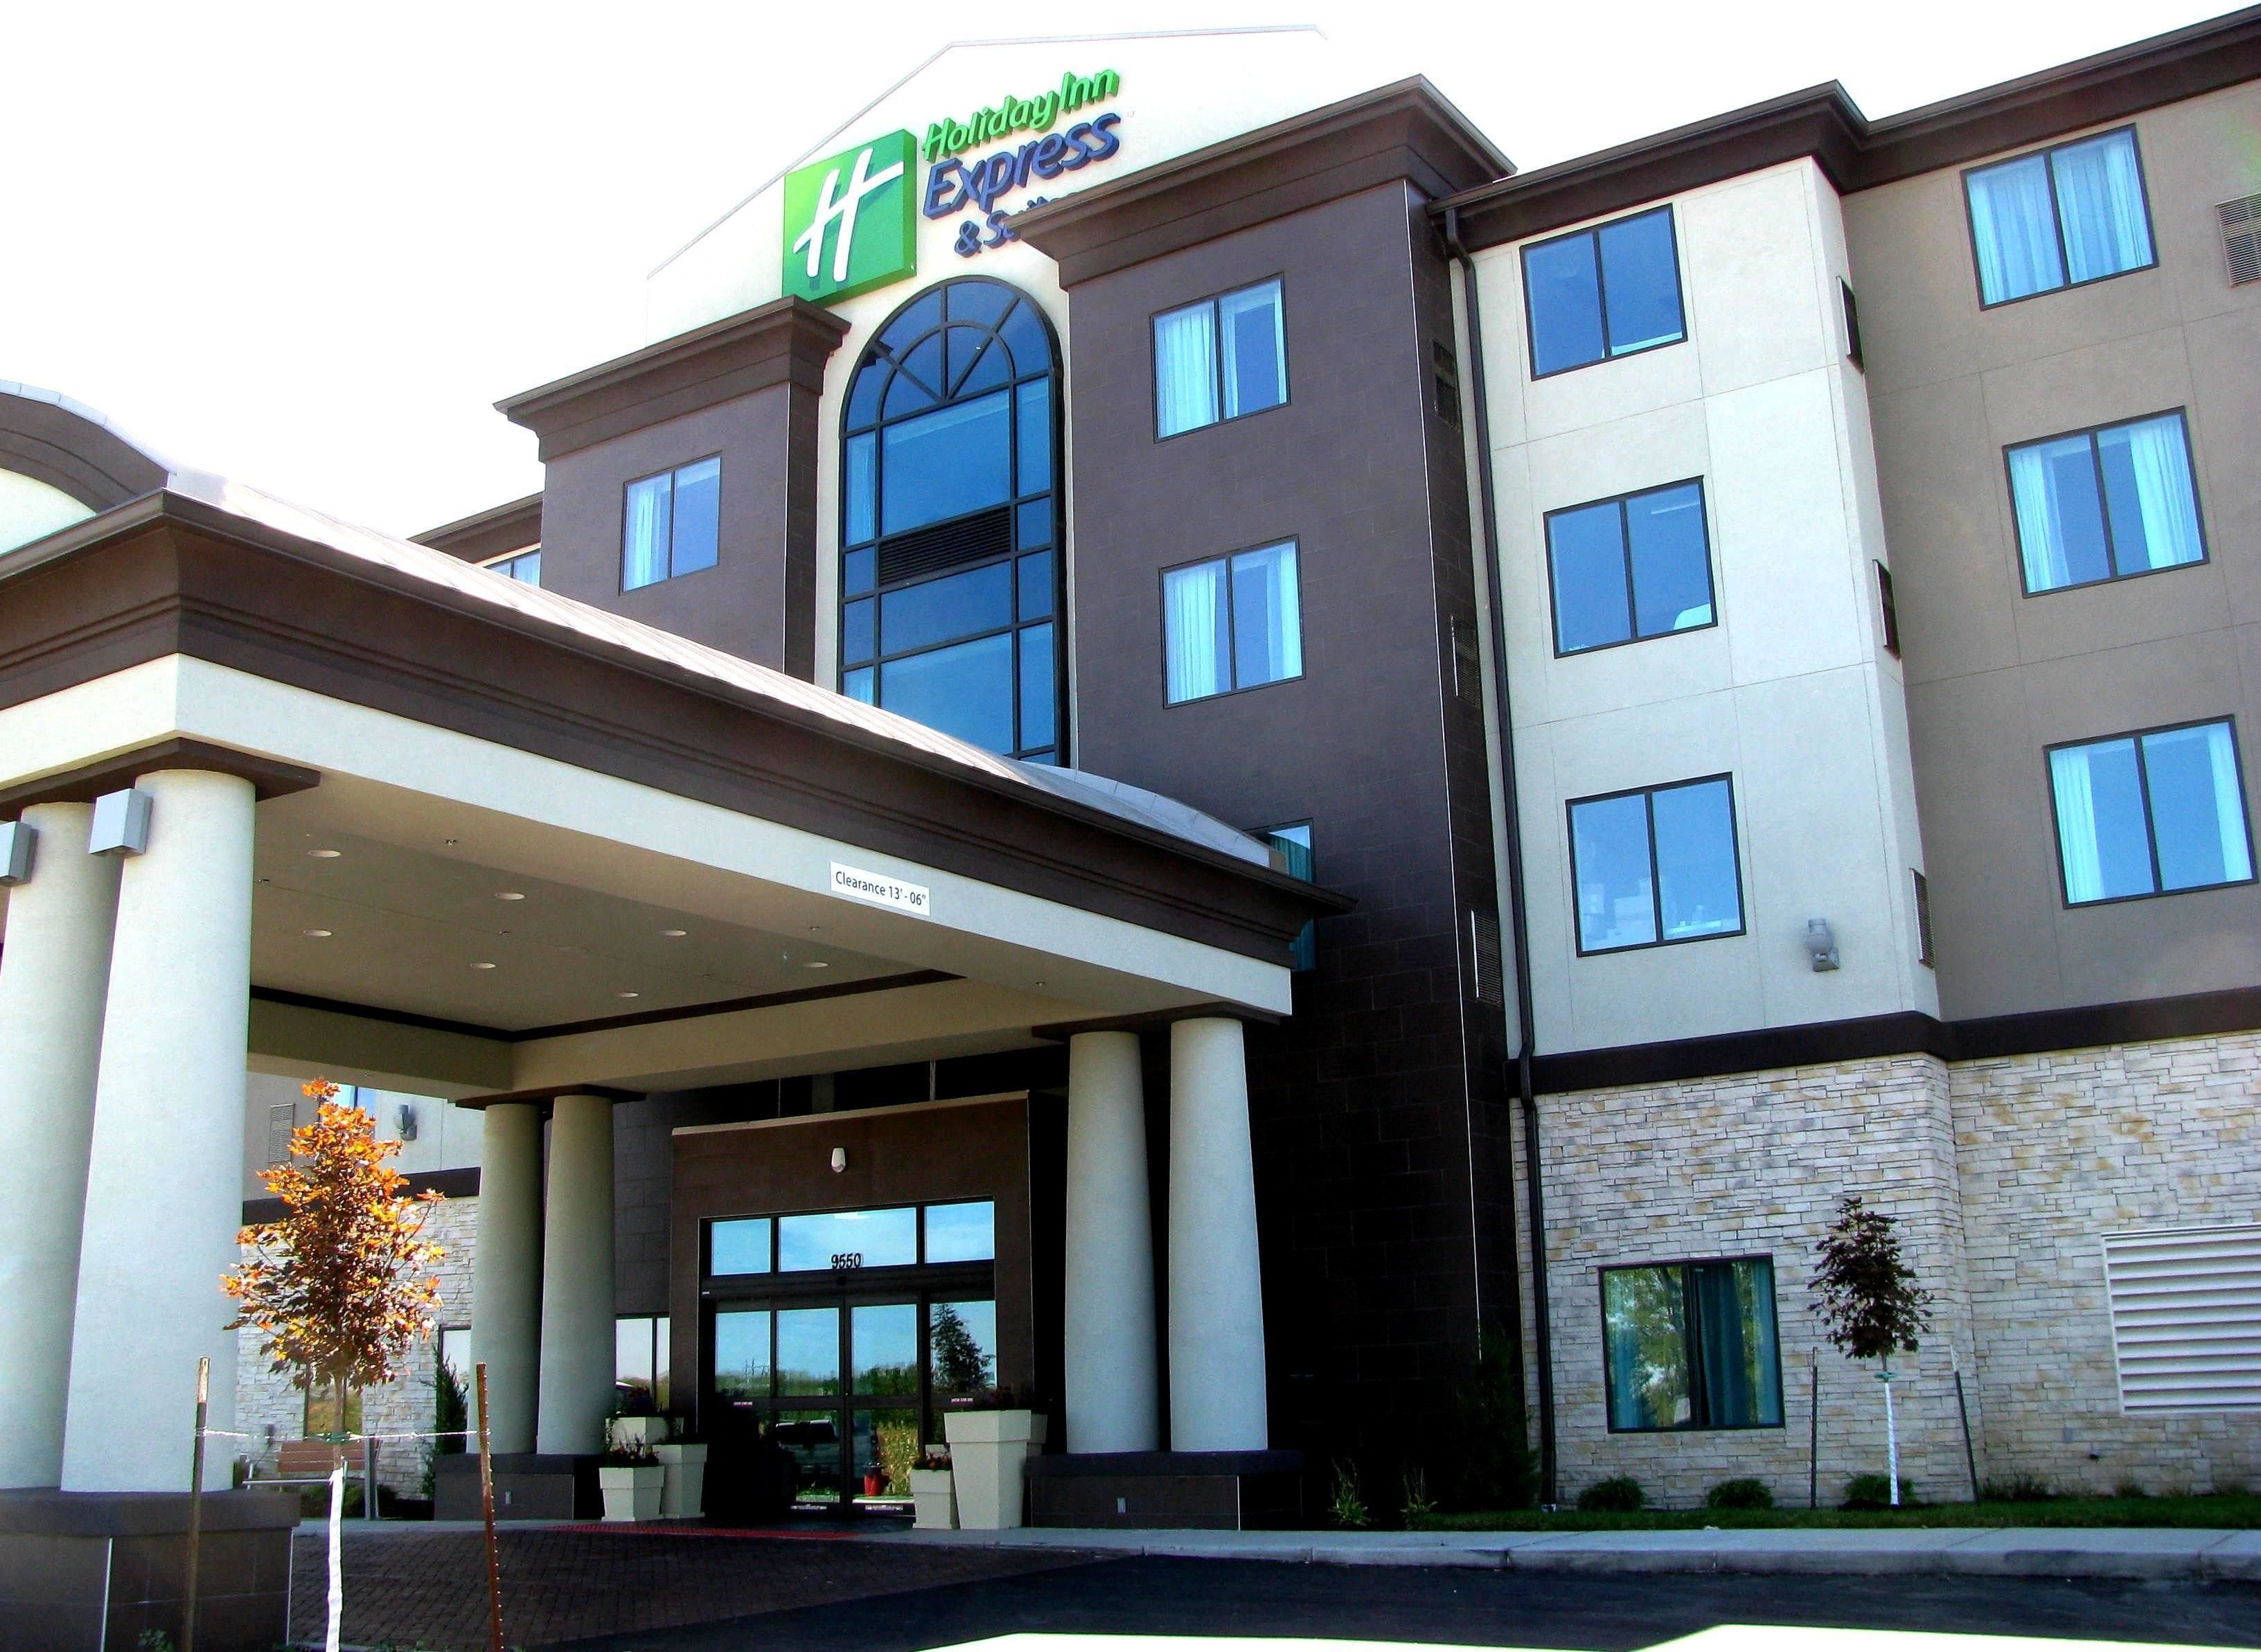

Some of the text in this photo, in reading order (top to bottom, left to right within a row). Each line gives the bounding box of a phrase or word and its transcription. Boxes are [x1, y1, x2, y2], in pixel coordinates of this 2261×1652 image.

[922, 69, 1120, 163] Holiday Inn
[923, 112, 1121, 220] Express
[954, 220, 982, 258] &
[835, 871, 886, 896] Clearance
[831, 1252, 862, 1270] 9550
